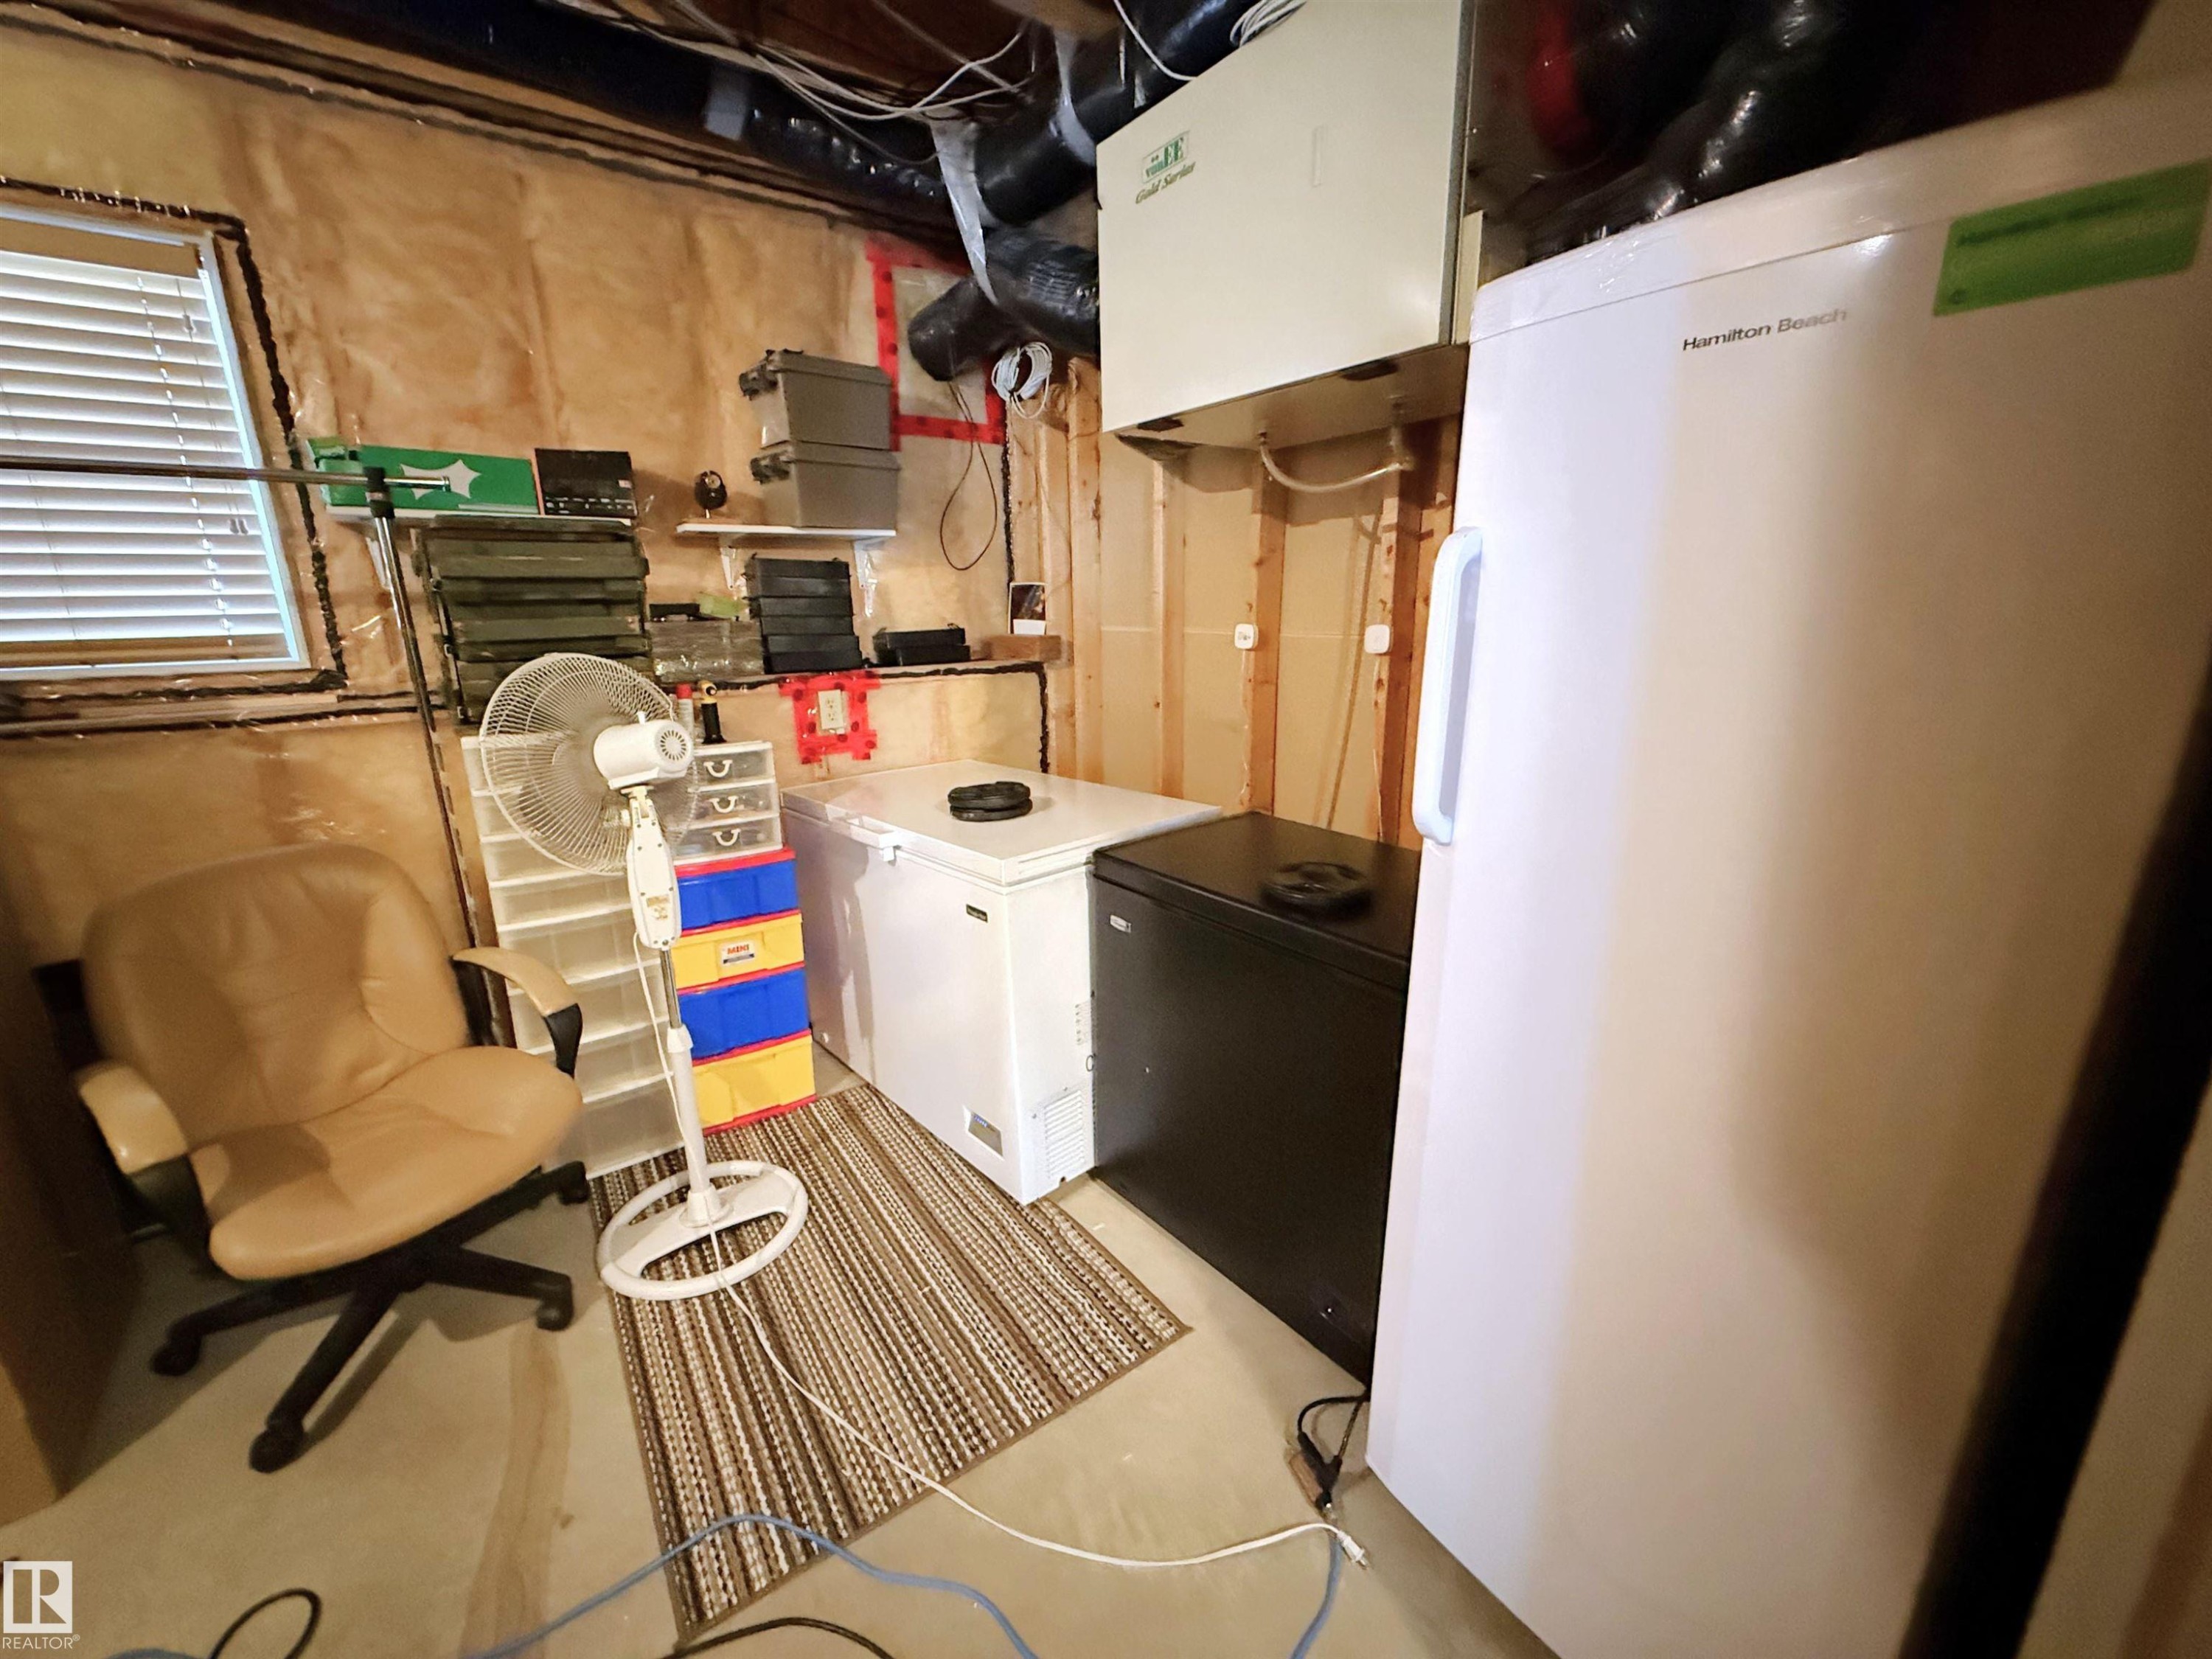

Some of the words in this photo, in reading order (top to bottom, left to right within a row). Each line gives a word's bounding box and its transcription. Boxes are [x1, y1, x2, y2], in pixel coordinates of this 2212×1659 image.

[1135, 178, 1162, 204] Gold
[1682, 323, 1772, 351] Hamilton
[1776, 308, 1848, 333] Beach
